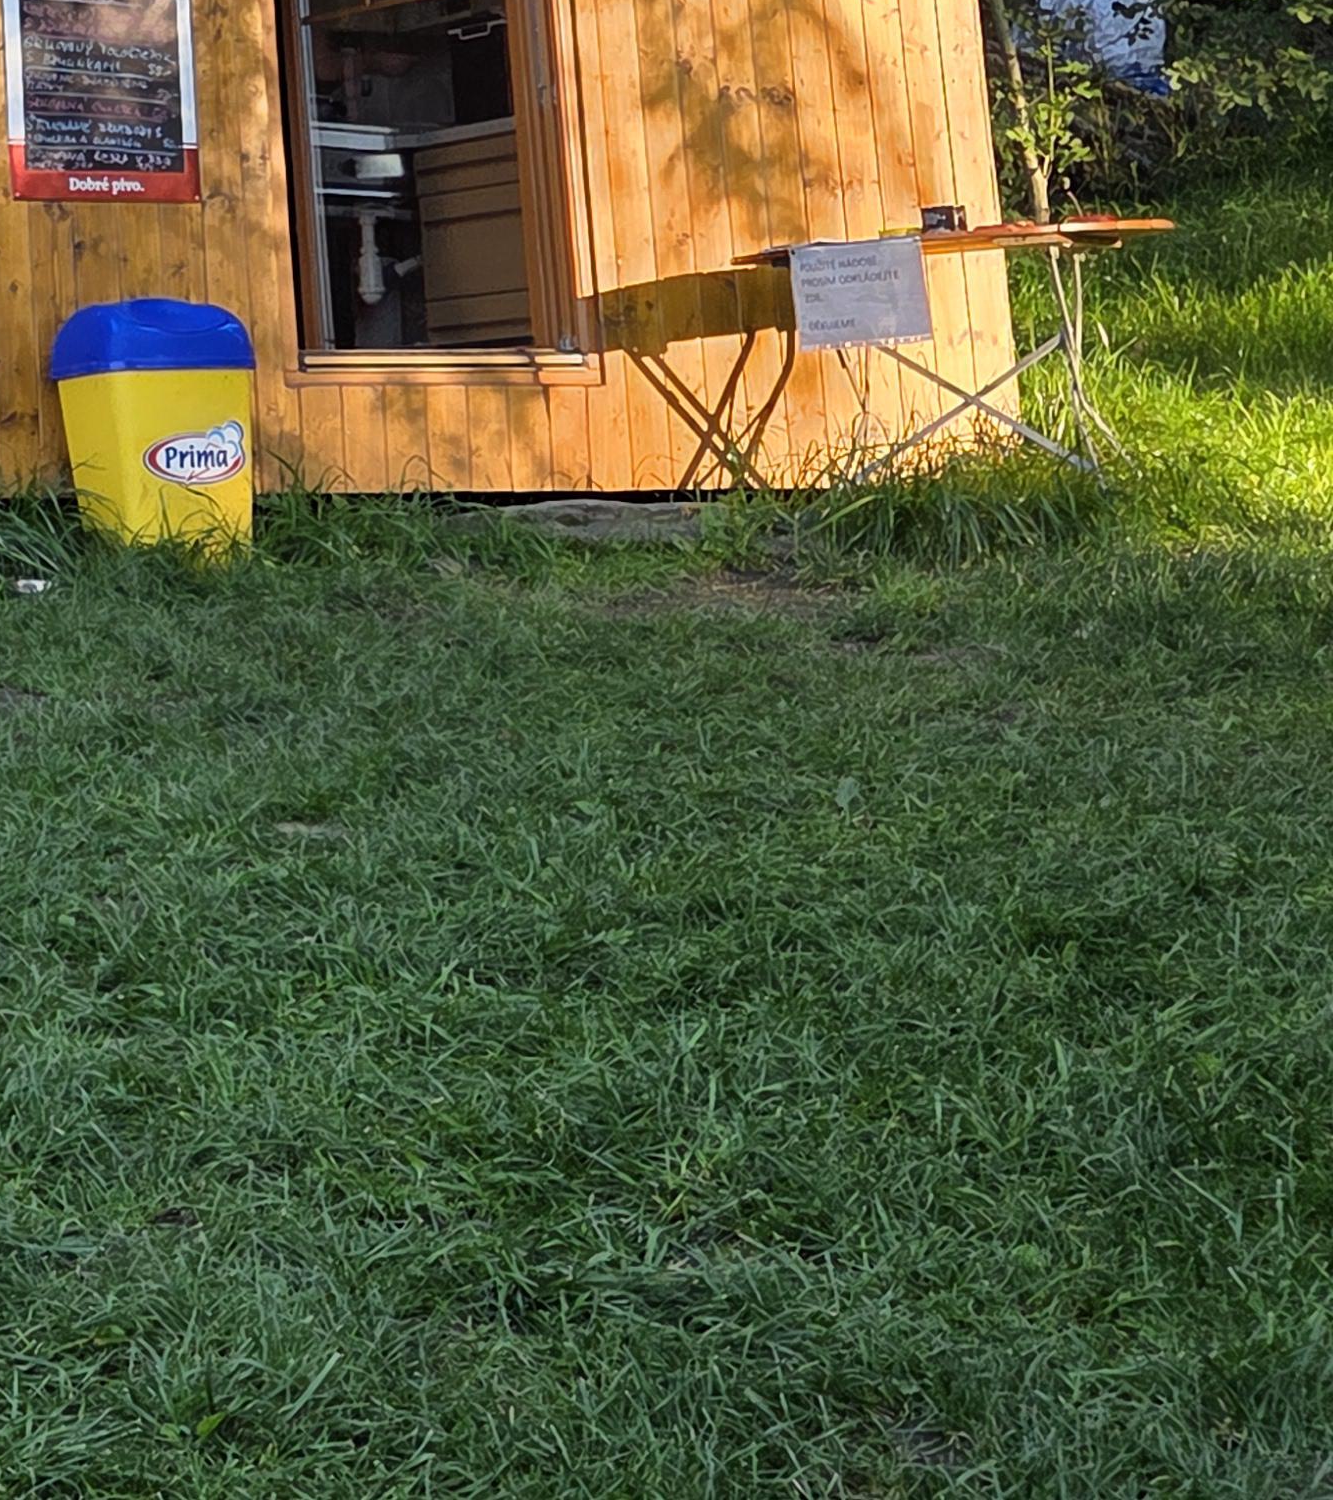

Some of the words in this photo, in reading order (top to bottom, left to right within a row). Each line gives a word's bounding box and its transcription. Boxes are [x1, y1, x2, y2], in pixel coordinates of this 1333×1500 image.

[69, 177, 110, 192] Dobré
[112, 179, 145, 195] pivo.
[164, 444, 229, 469] Prima
